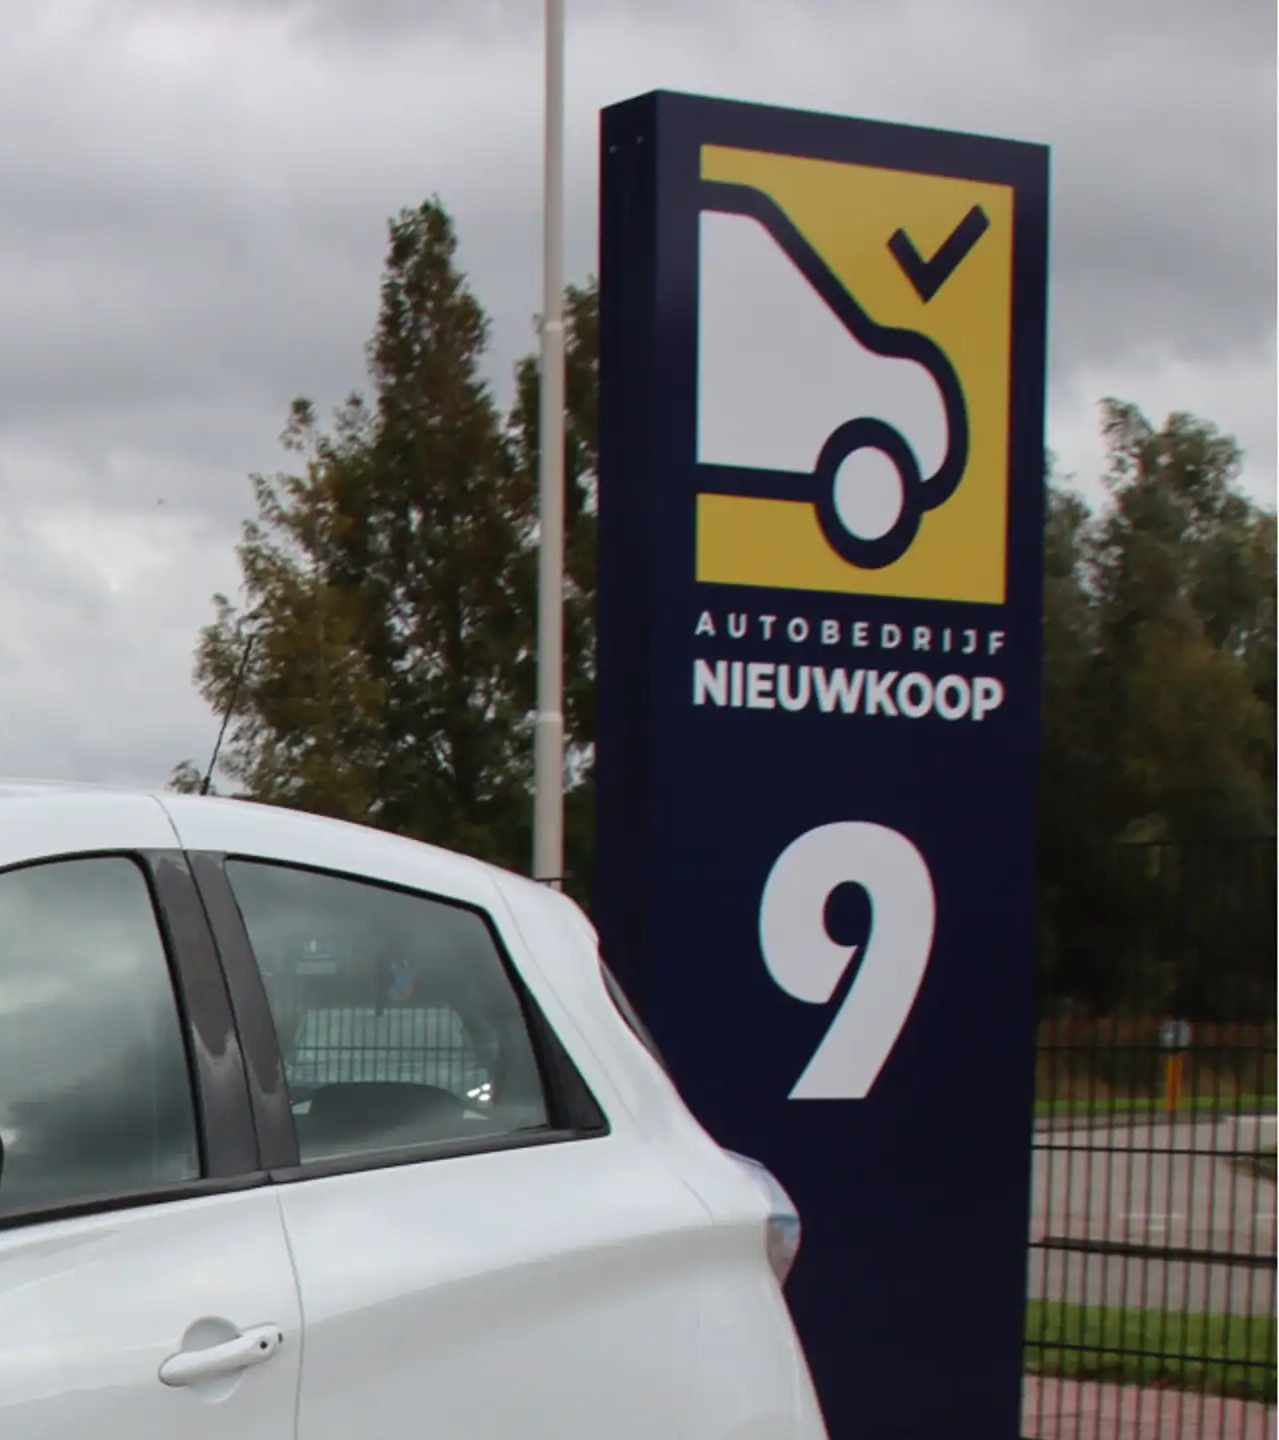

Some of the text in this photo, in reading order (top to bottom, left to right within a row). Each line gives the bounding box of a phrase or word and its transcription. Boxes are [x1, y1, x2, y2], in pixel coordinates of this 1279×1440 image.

[694, 610, 1006, 656] AUTOBEDRIJF
[692, 658, 1005, 722] NIEUWKOOP
[758, 820, 936, 1100] 9
